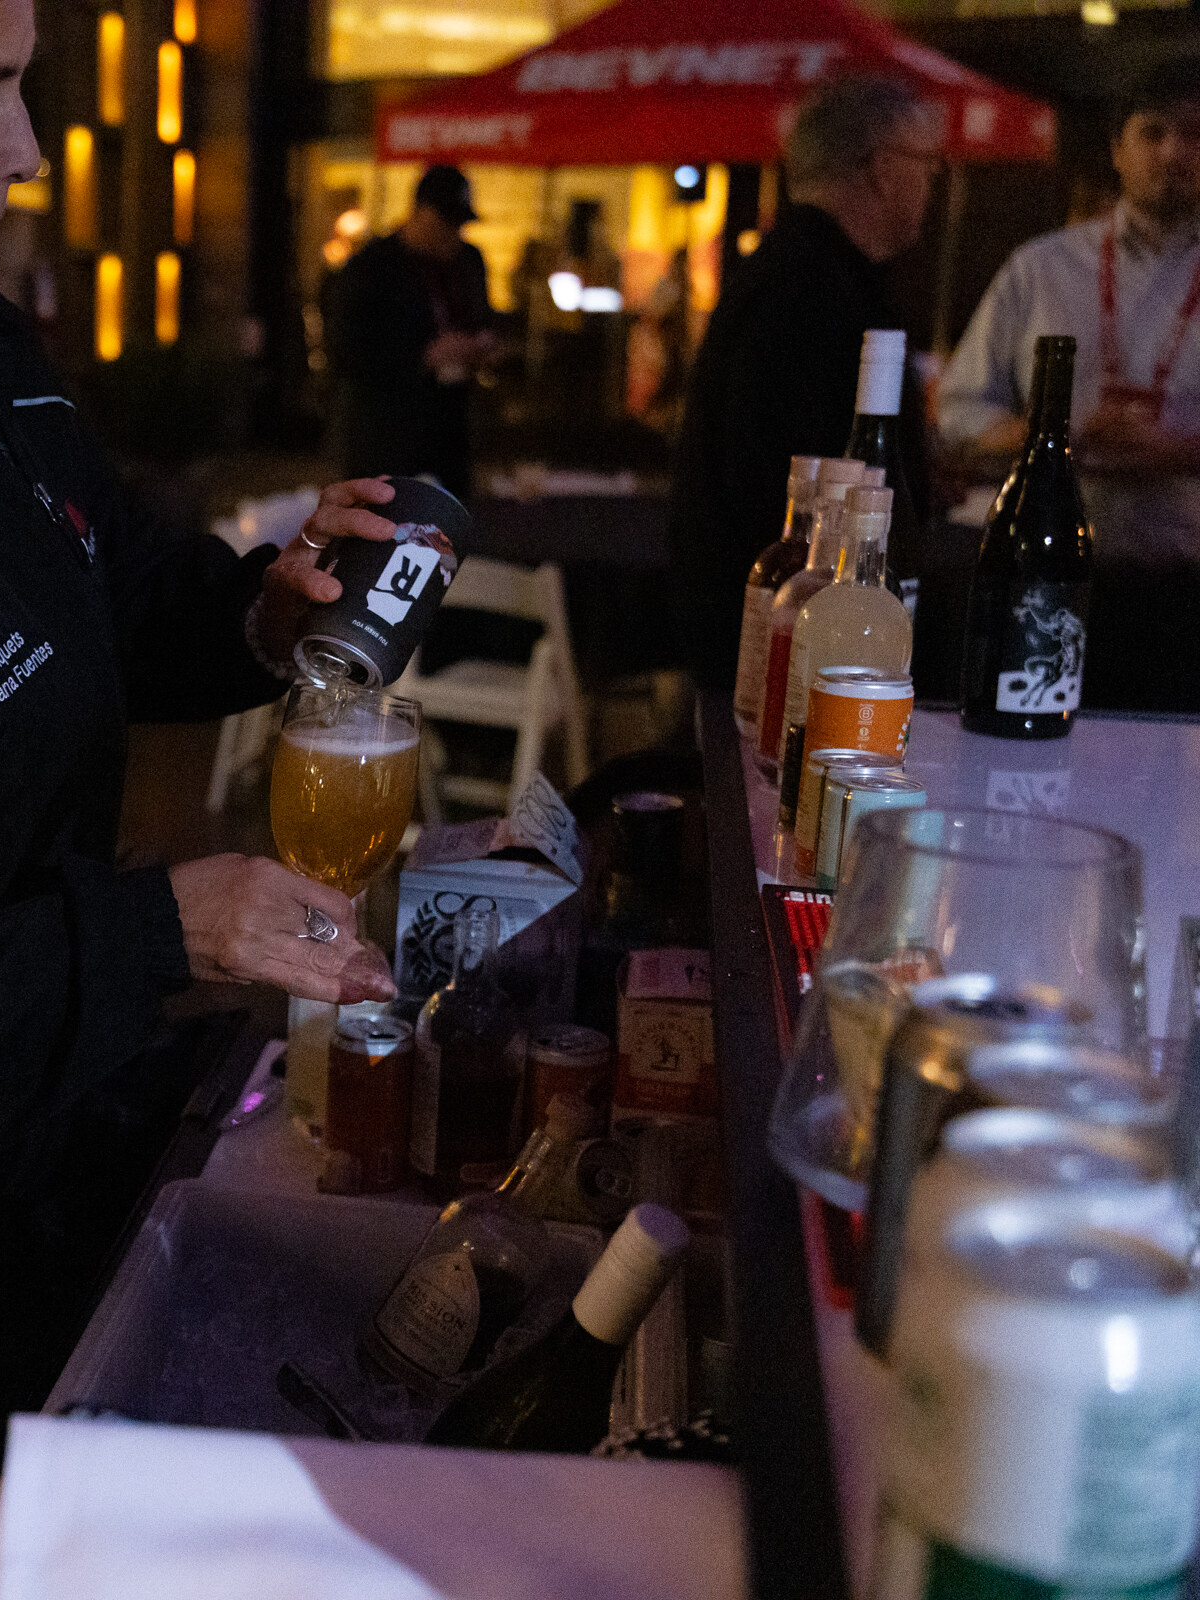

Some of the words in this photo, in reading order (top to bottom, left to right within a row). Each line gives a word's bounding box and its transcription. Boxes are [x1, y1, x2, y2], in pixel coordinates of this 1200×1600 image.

[517, 41, 842, 92] BEVNET
[390, 555, 422, 600] R
[13, 641, 53, 684] Fuentes
